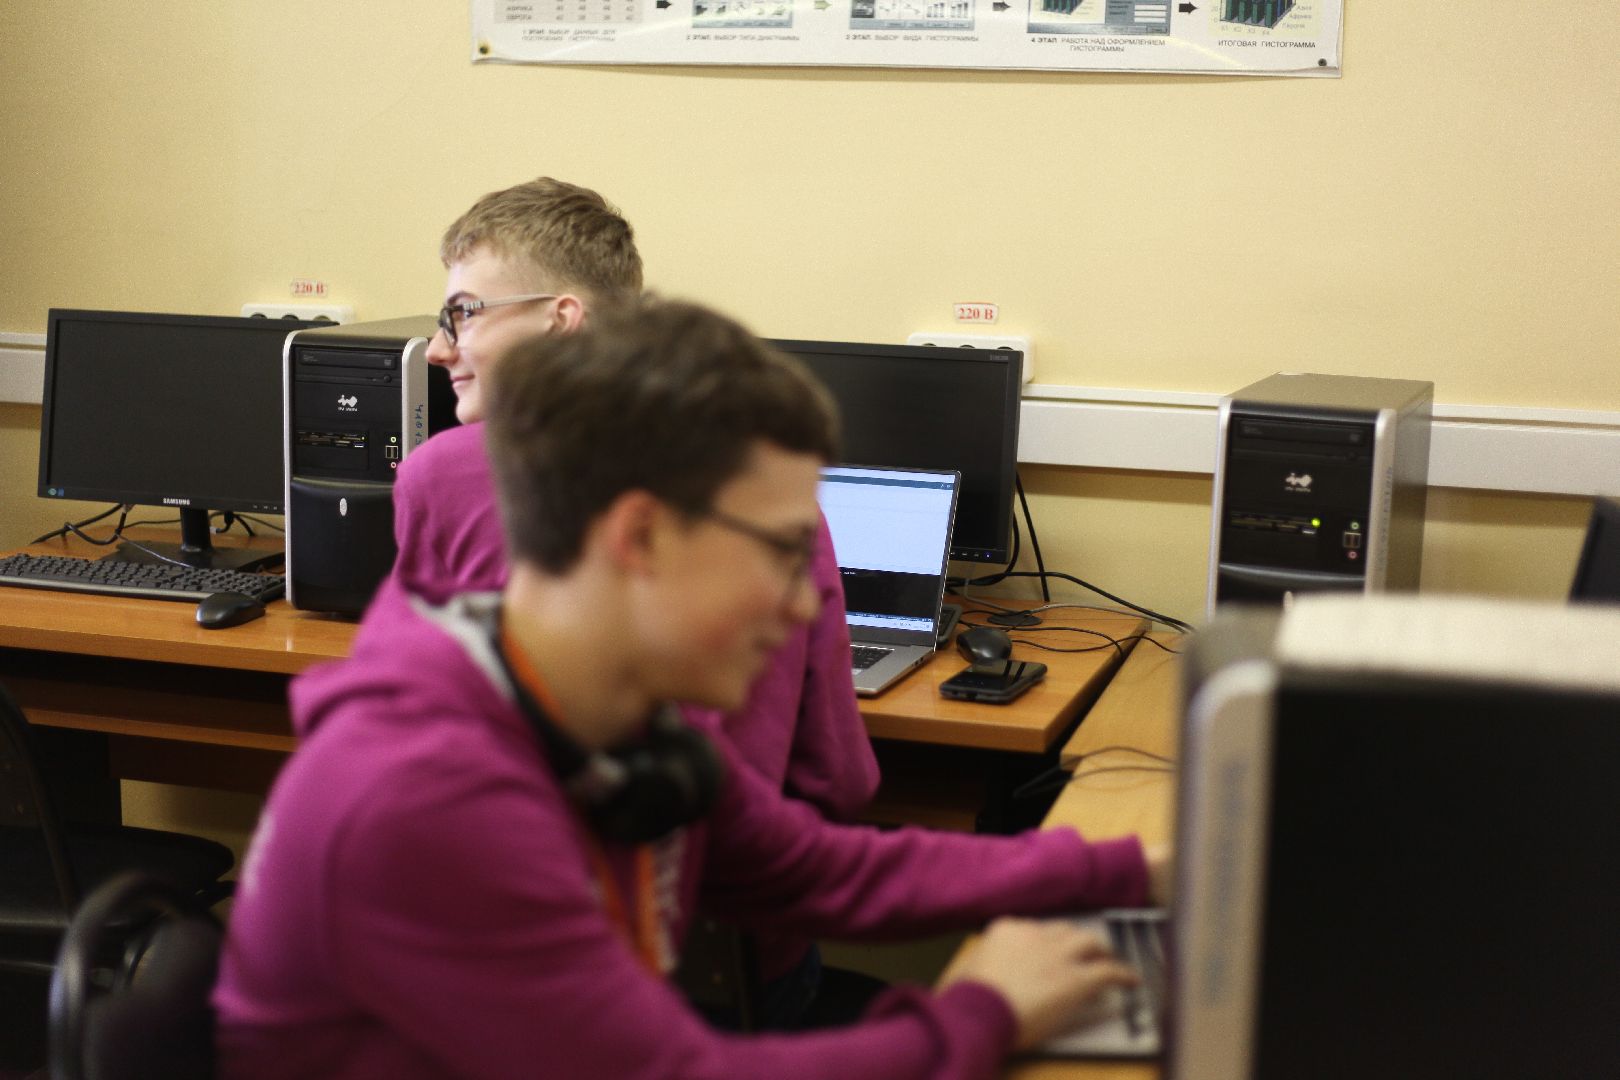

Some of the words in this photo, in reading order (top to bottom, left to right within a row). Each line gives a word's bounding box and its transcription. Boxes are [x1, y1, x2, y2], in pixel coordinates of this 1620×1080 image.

[1107, 38, 1166, 46] ОФОРМЛЕНИЕМ
[1218, 39, 1257, 47] ИТОГОВАЯ
[1261, 40, 1316, 48] ГИСТОГРАММА
[1070, 44, 1125, 52] ГИСТОГРАММЫ
[294, 281, 313, 294] 220
[958, 308, 980, 319] 220
[163, 497, 190, 505] SAMSUNG
